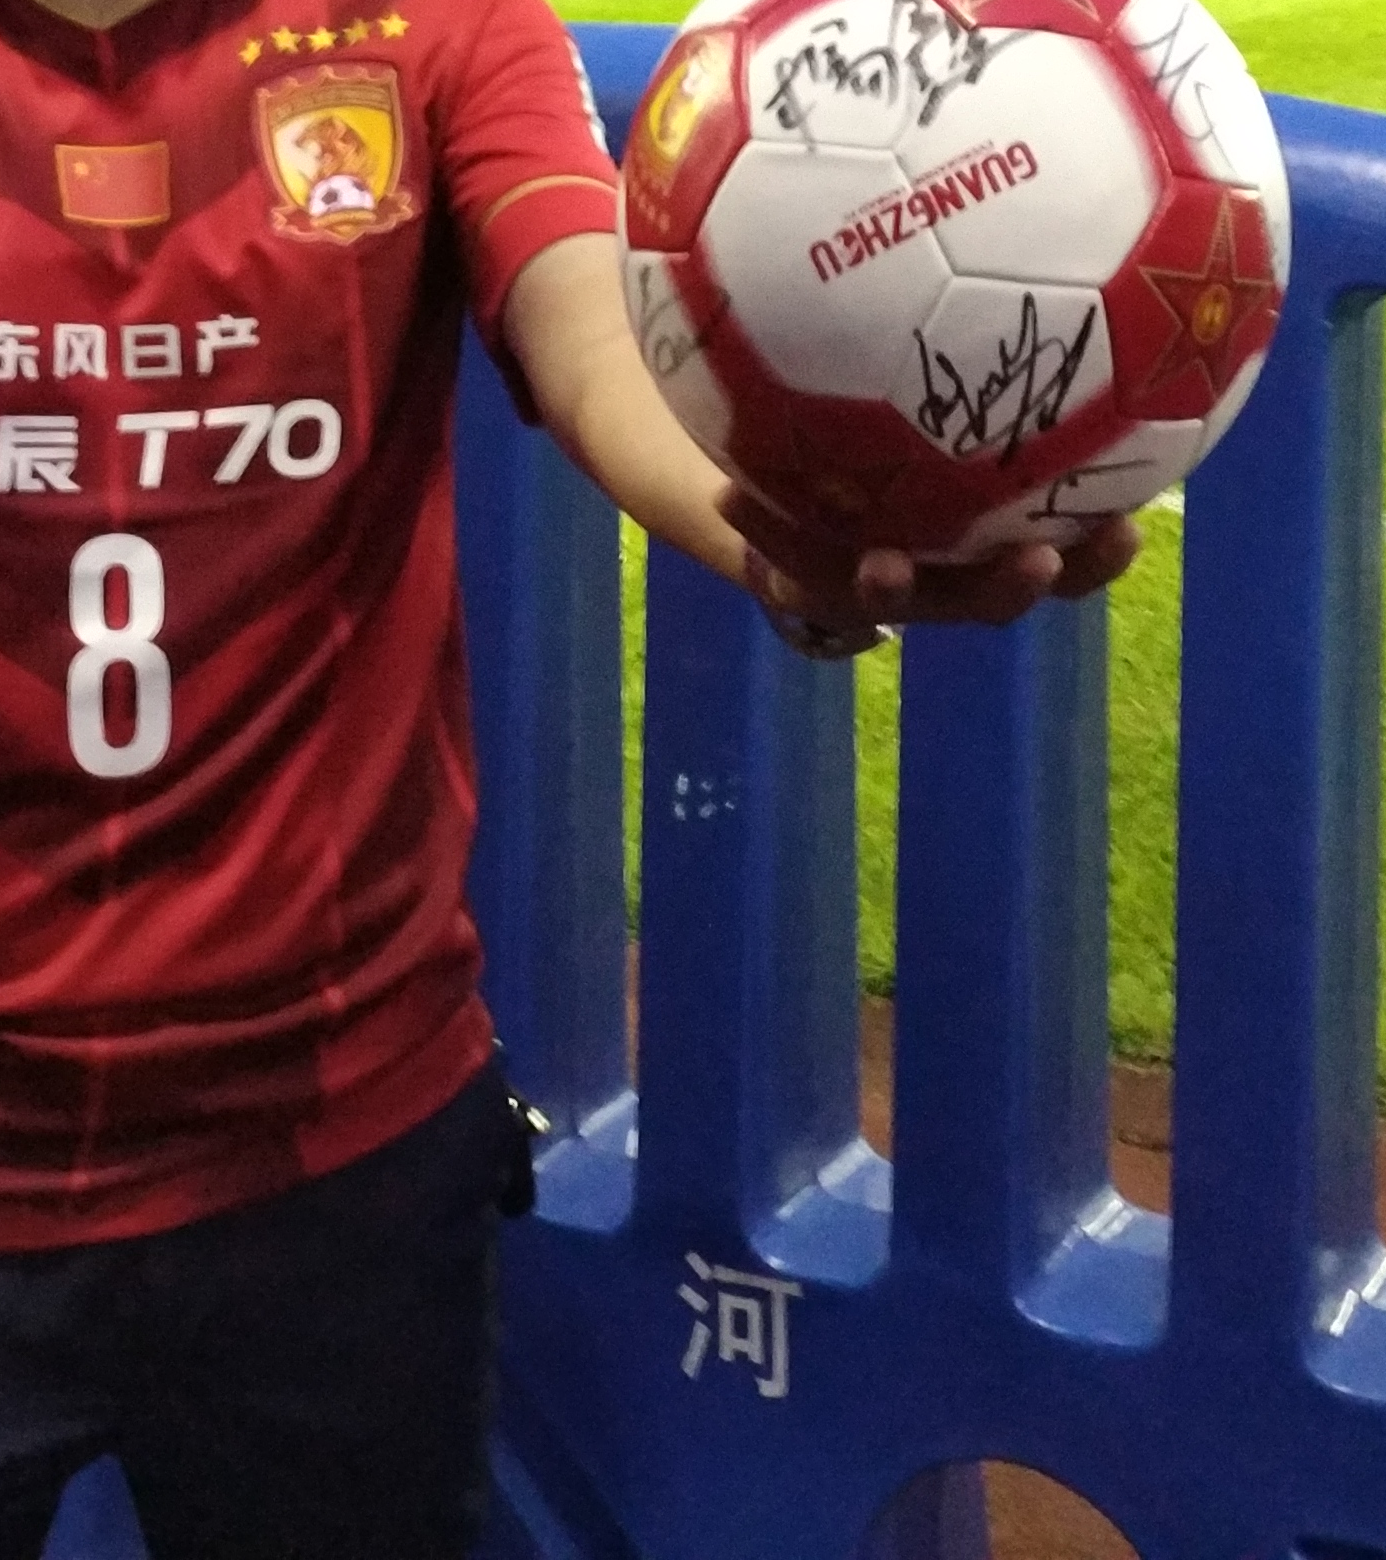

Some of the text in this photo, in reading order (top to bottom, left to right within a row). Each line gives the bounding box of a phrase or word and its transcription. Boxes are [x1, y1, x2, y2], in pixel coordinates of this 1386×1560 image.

[115, 398, 343, 489] T70
[65, 531, 172, 780] 8
[676, 1250, 805, 1399] 河
